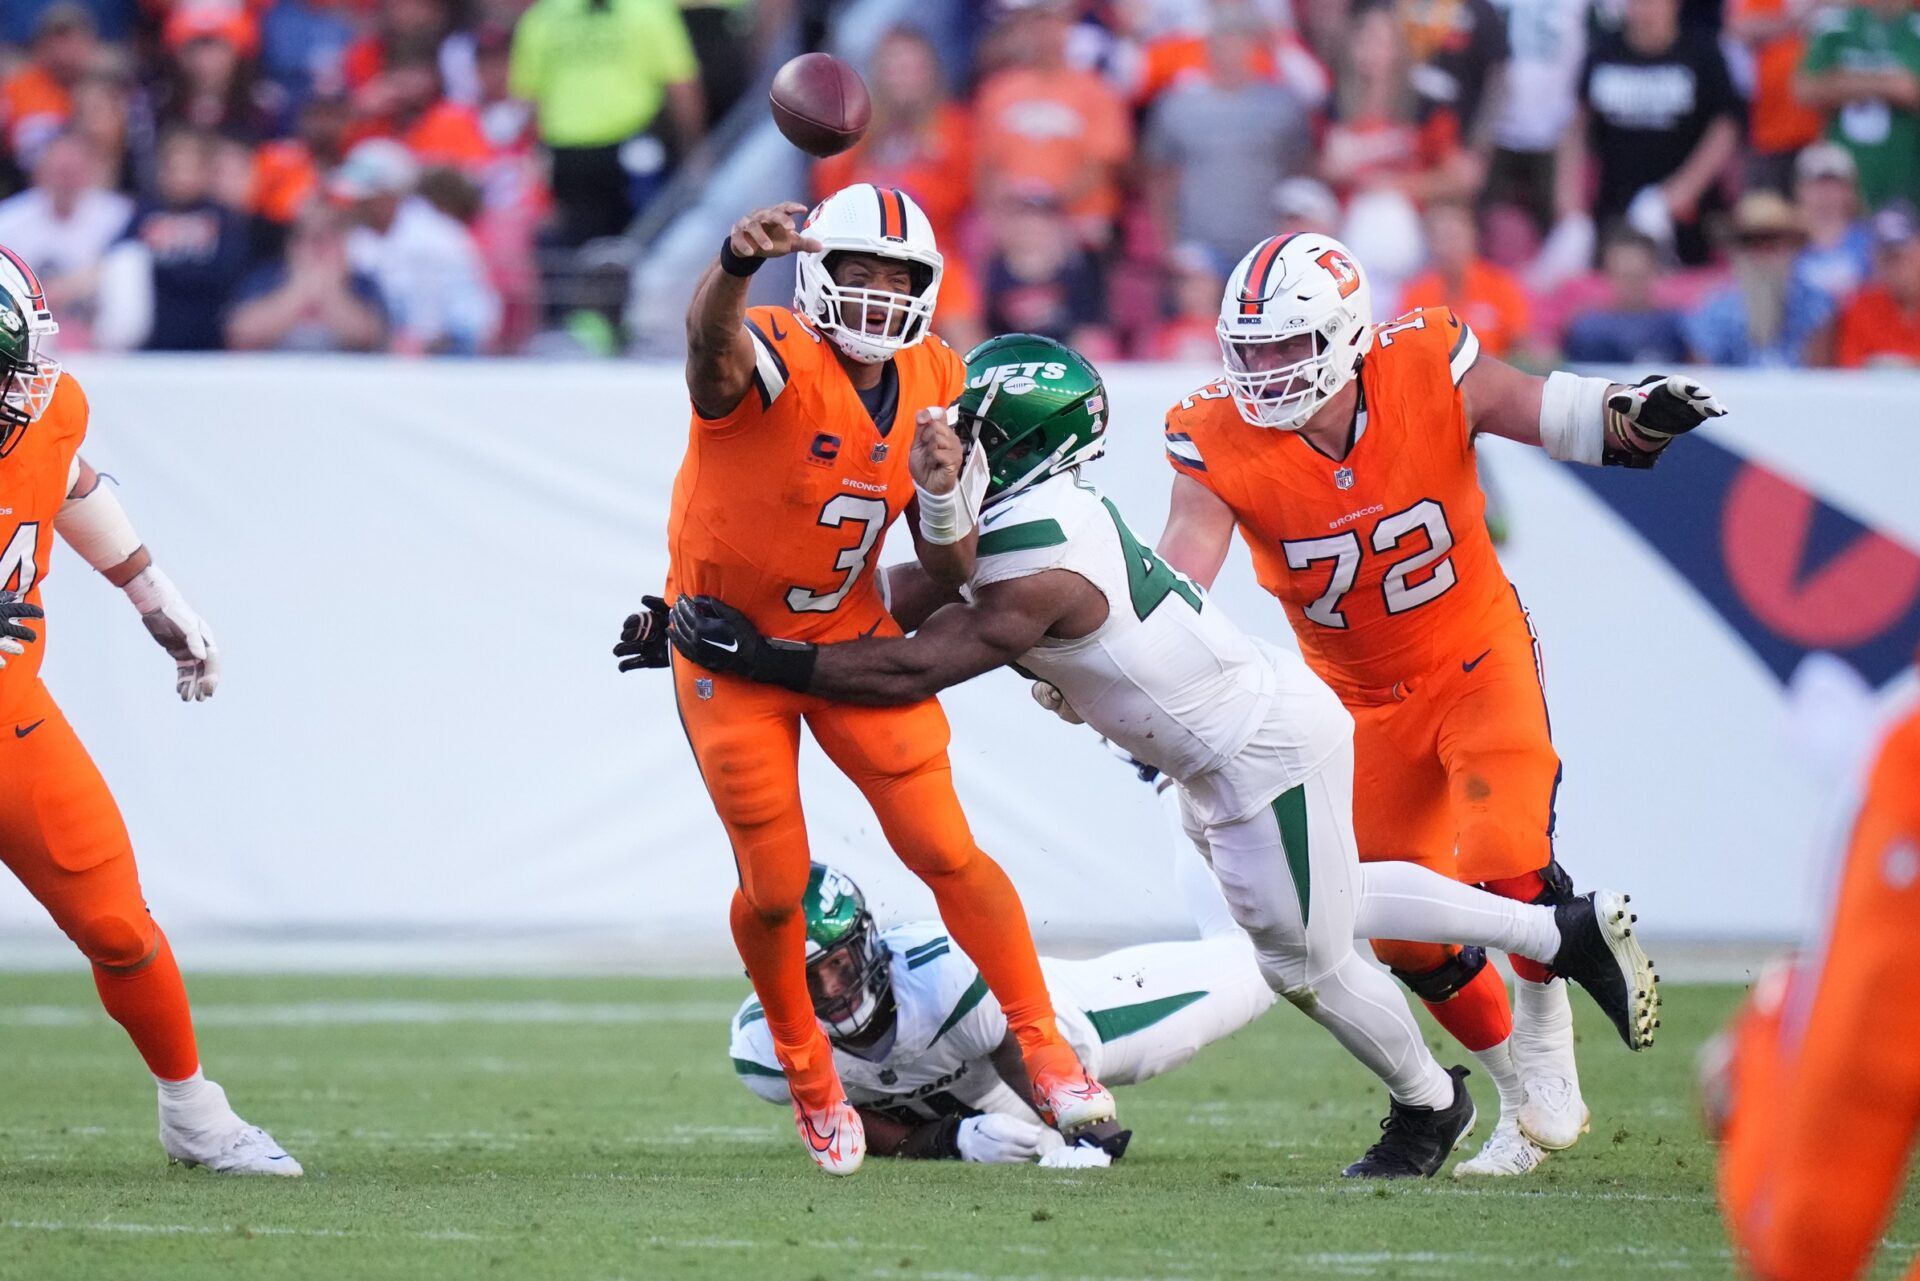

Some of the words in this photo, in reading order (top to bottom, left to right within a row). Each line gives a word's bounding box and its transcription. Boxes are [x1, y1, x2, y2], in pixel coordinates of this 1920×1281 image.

[970, 362, 1067, 389] JETS
[784, 492, 889, 614] 3
[1329, 504, 1384, 529] BRONCOS
[1279, 497, 1459, 629] 72
